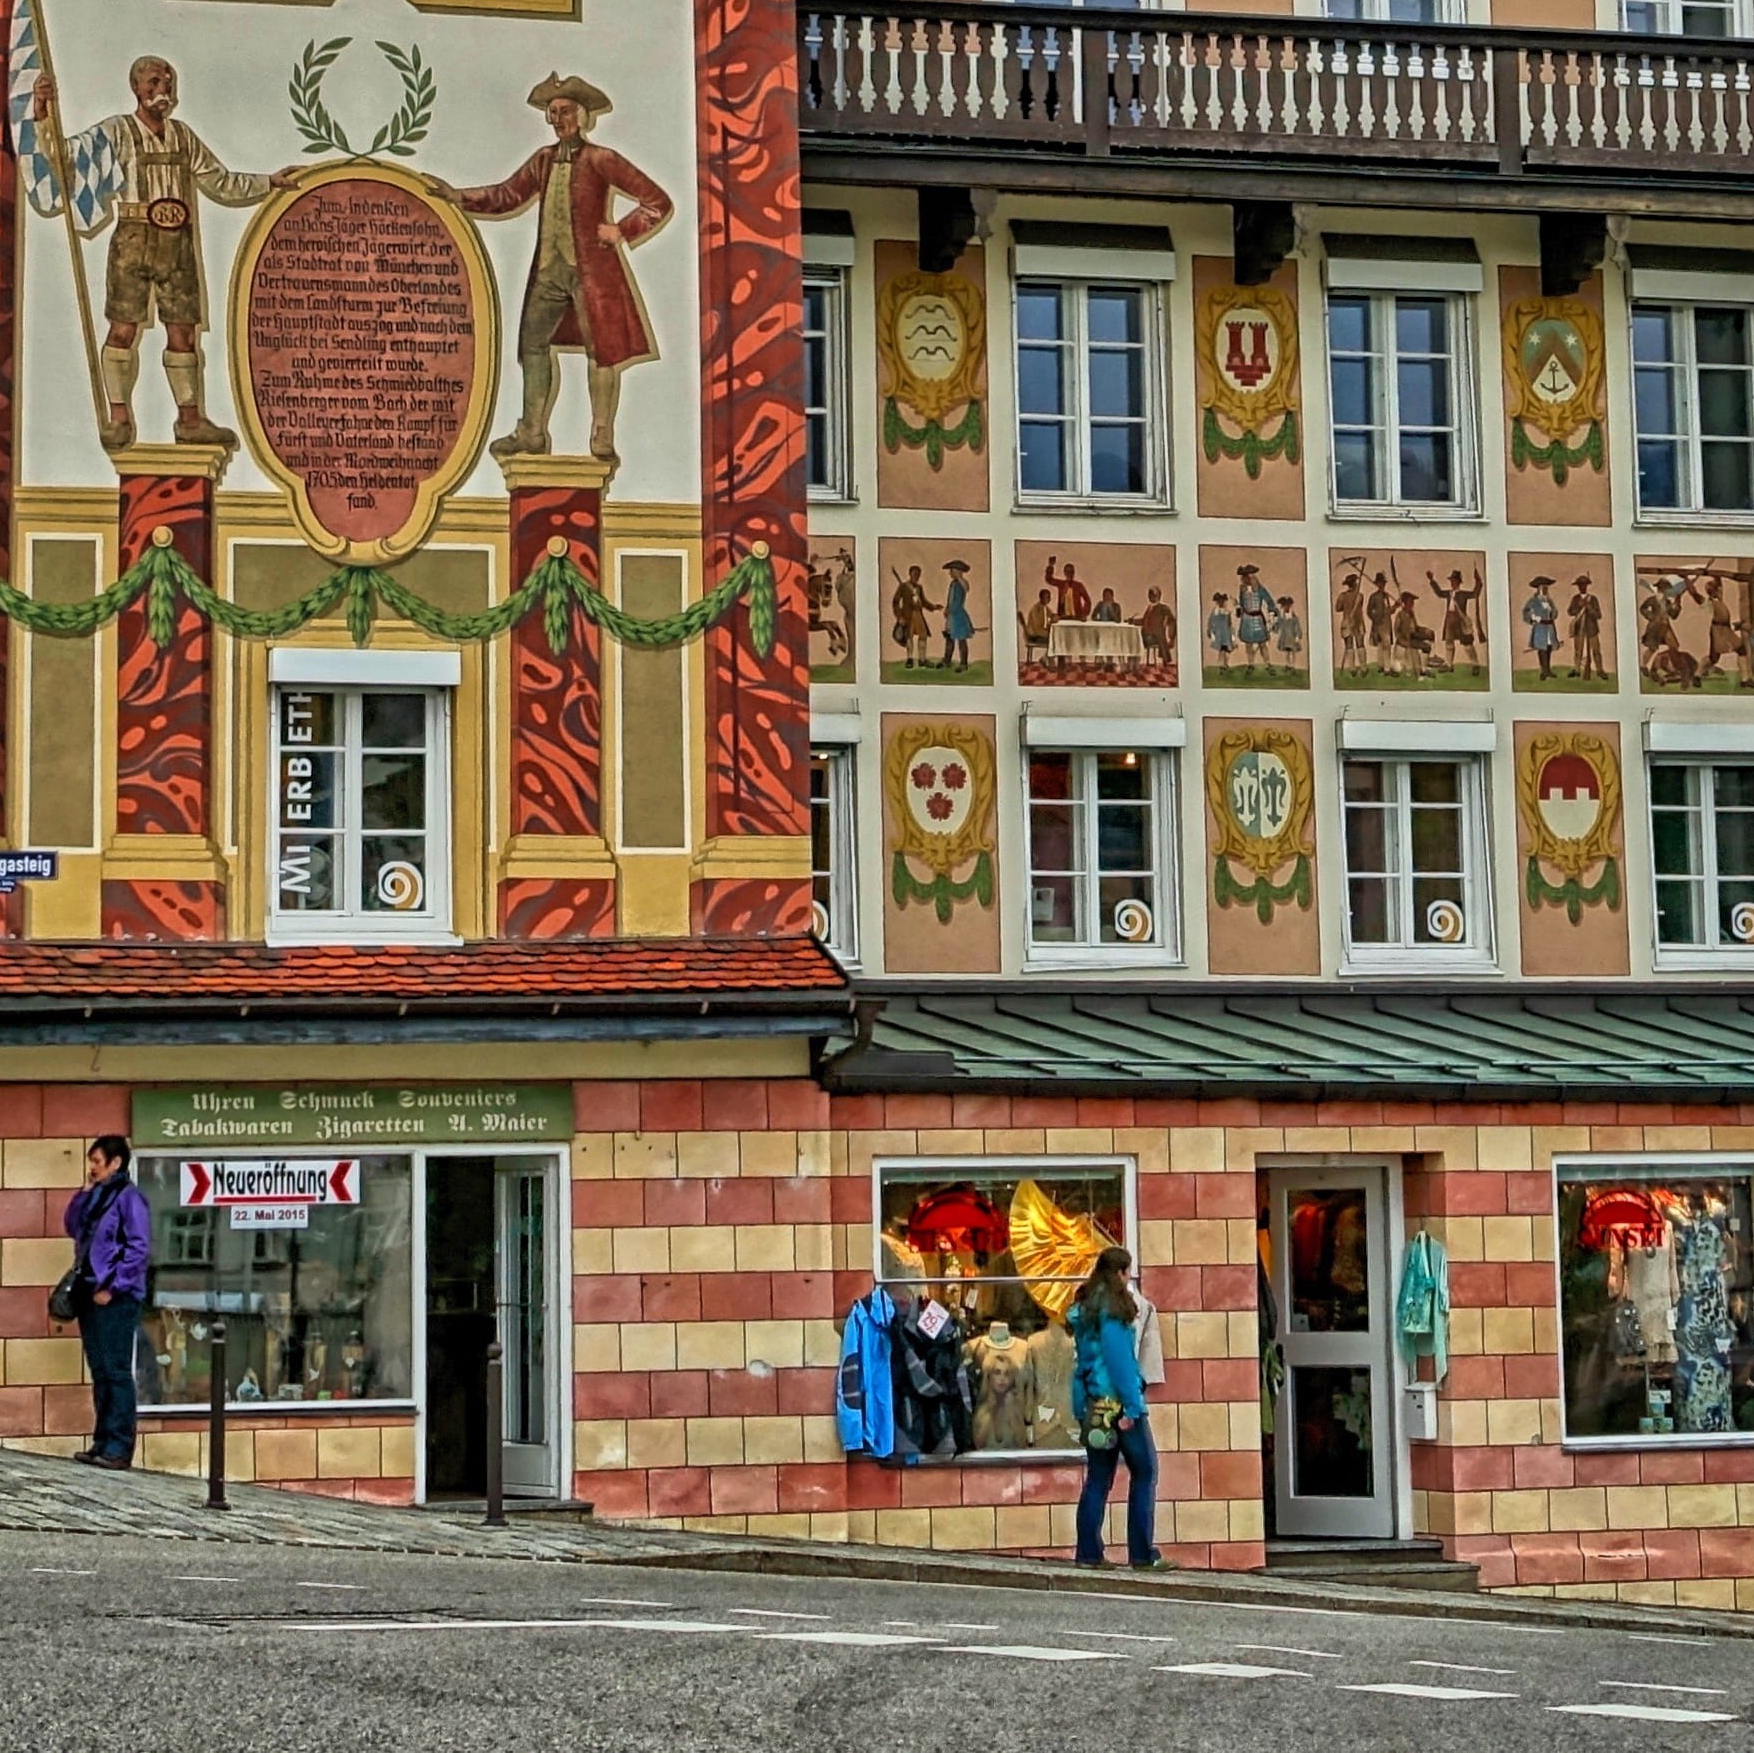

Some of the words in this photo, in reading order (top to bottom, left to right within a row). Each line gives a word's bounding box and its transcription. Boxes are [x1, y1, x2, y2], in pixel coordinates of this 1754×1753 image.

[336, 216, 366, 239] Jäger
[263, 255, 283, 270] als
[286, 257, 343, 272] Stadtrat
[374, 258, 433, 277] München
[434, 260, 459, 276] und
[390, 278, 461, 296] Oberlandes
[279, 294, 304, 310] dem
[375, 299, 397, 318] zur
[252, 313, 271, 328] der
[273, 313, 346, 332] Hauptstadt
[309, 333, 329, 348] bei
[331, 334, 387, 355] Sendling
[389, 337, 461, 359] enthauptet
[291, 352, 316, 368] und
[259, 370, 291, 388] Zum
[292, 371, 340, 392] Ruhme
[431, 398, 455, 413] mit
[267, 411, 288, 429] der
[335, 432, 395, 449] Vaterland
[192, 1093, 255, 1114] Uhren
[279, 1090, 375, 1112] Schmuck
[160, 1118, 293, 1137] Tabakwaren
[316, 1115, 425, 1139] Zigaretten
[481, 1113, 547, 1132] Maier
[212, 1161, 327, 1201] Neueröffnung
[234, 1211, 251, 1221] 22.
[255, 1210, 275, 1220] Mai
[278, 1209, 305, 1220] 2015
